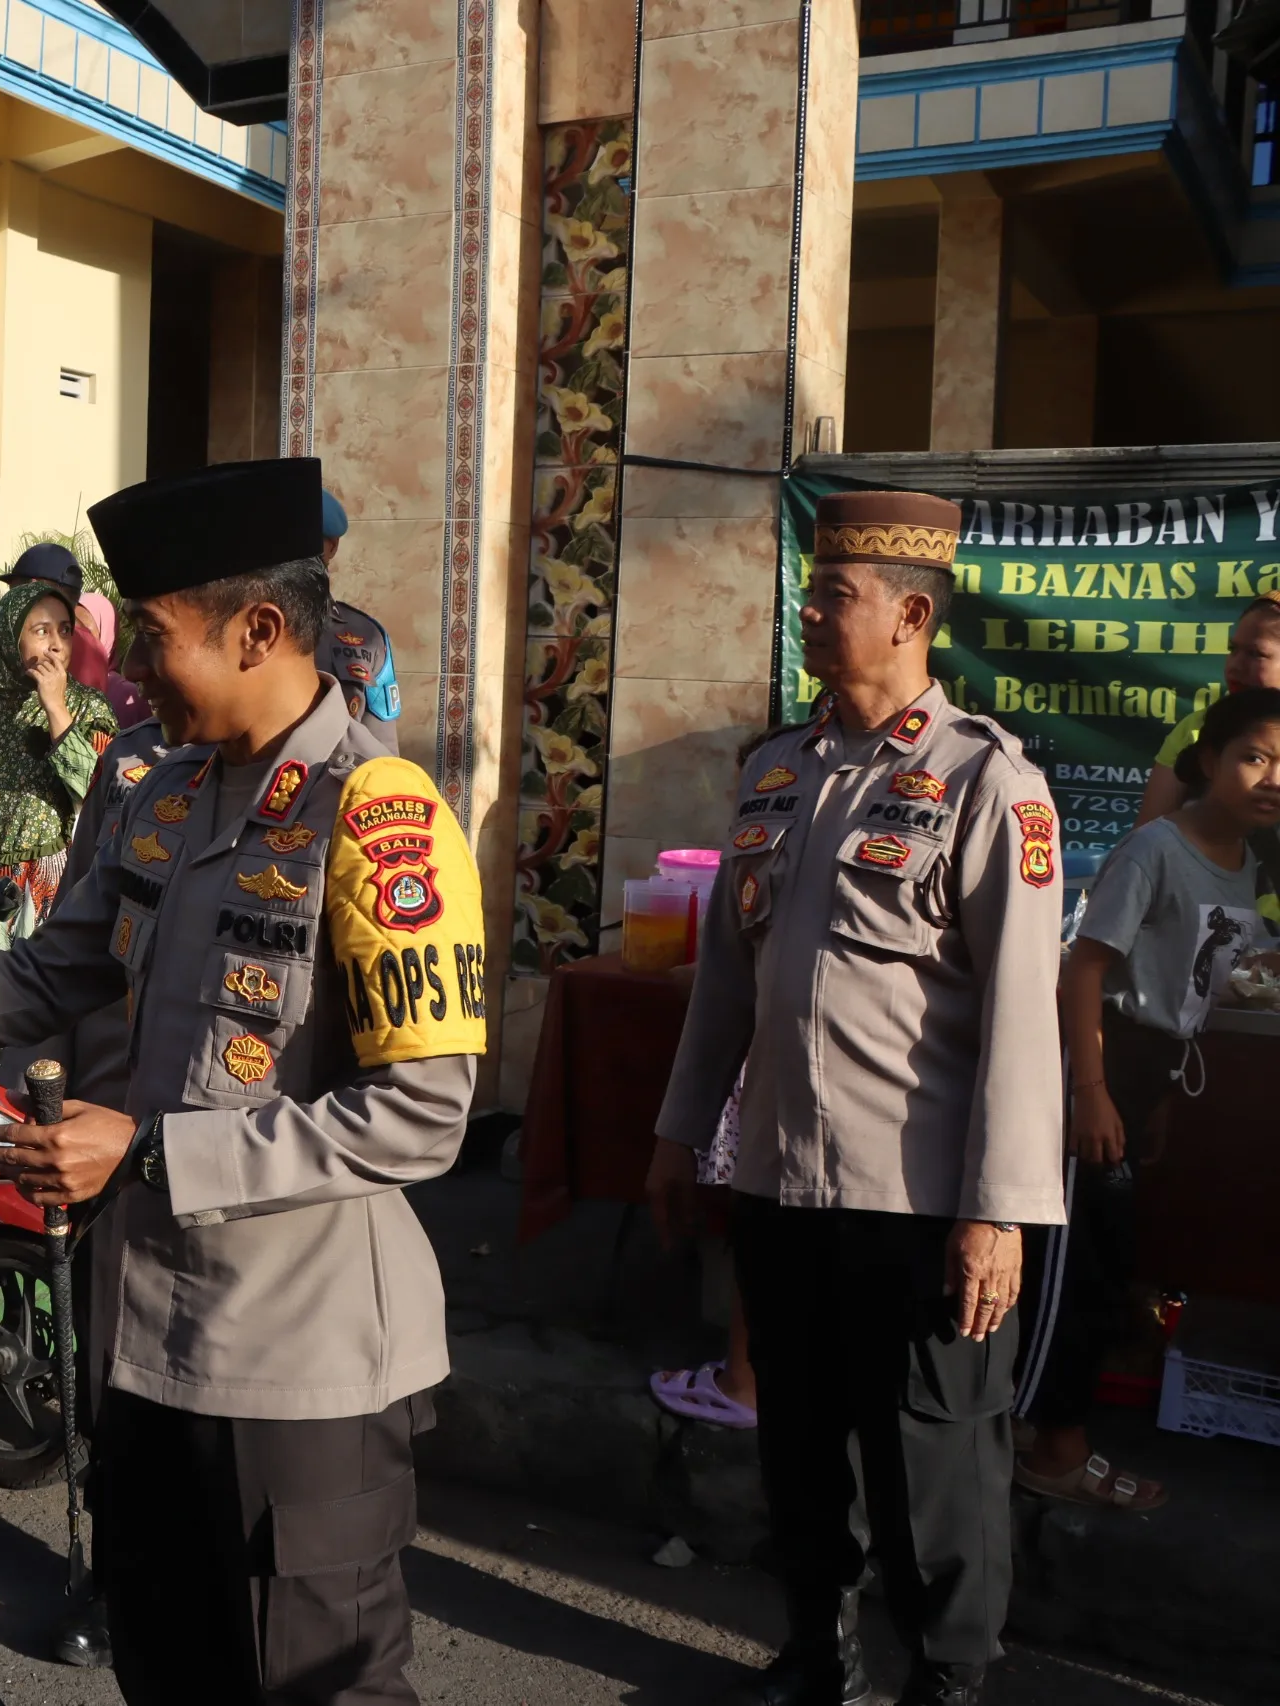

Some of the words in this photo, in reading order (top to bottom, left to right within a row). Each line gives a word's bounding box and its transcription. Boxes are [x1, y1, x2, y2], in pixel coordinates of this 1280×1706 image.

[950, 494, 1226, 547] ARHABAN
[999, 561, 1196, 600] BAZNAS
[980, 617, 1235, 654] LEBIH
[993, 675, 1177, 724] Berinfaq
[358, 800, 426, 822] POLRES
[358, 811, 427, 832] KARANGASEM
[867, 802, 946, 833] POLRI
[379, 838, 421, 853] BALI
[216, 909, 309, 955] POLRI
[380, 943, 448, 1029] OPS
